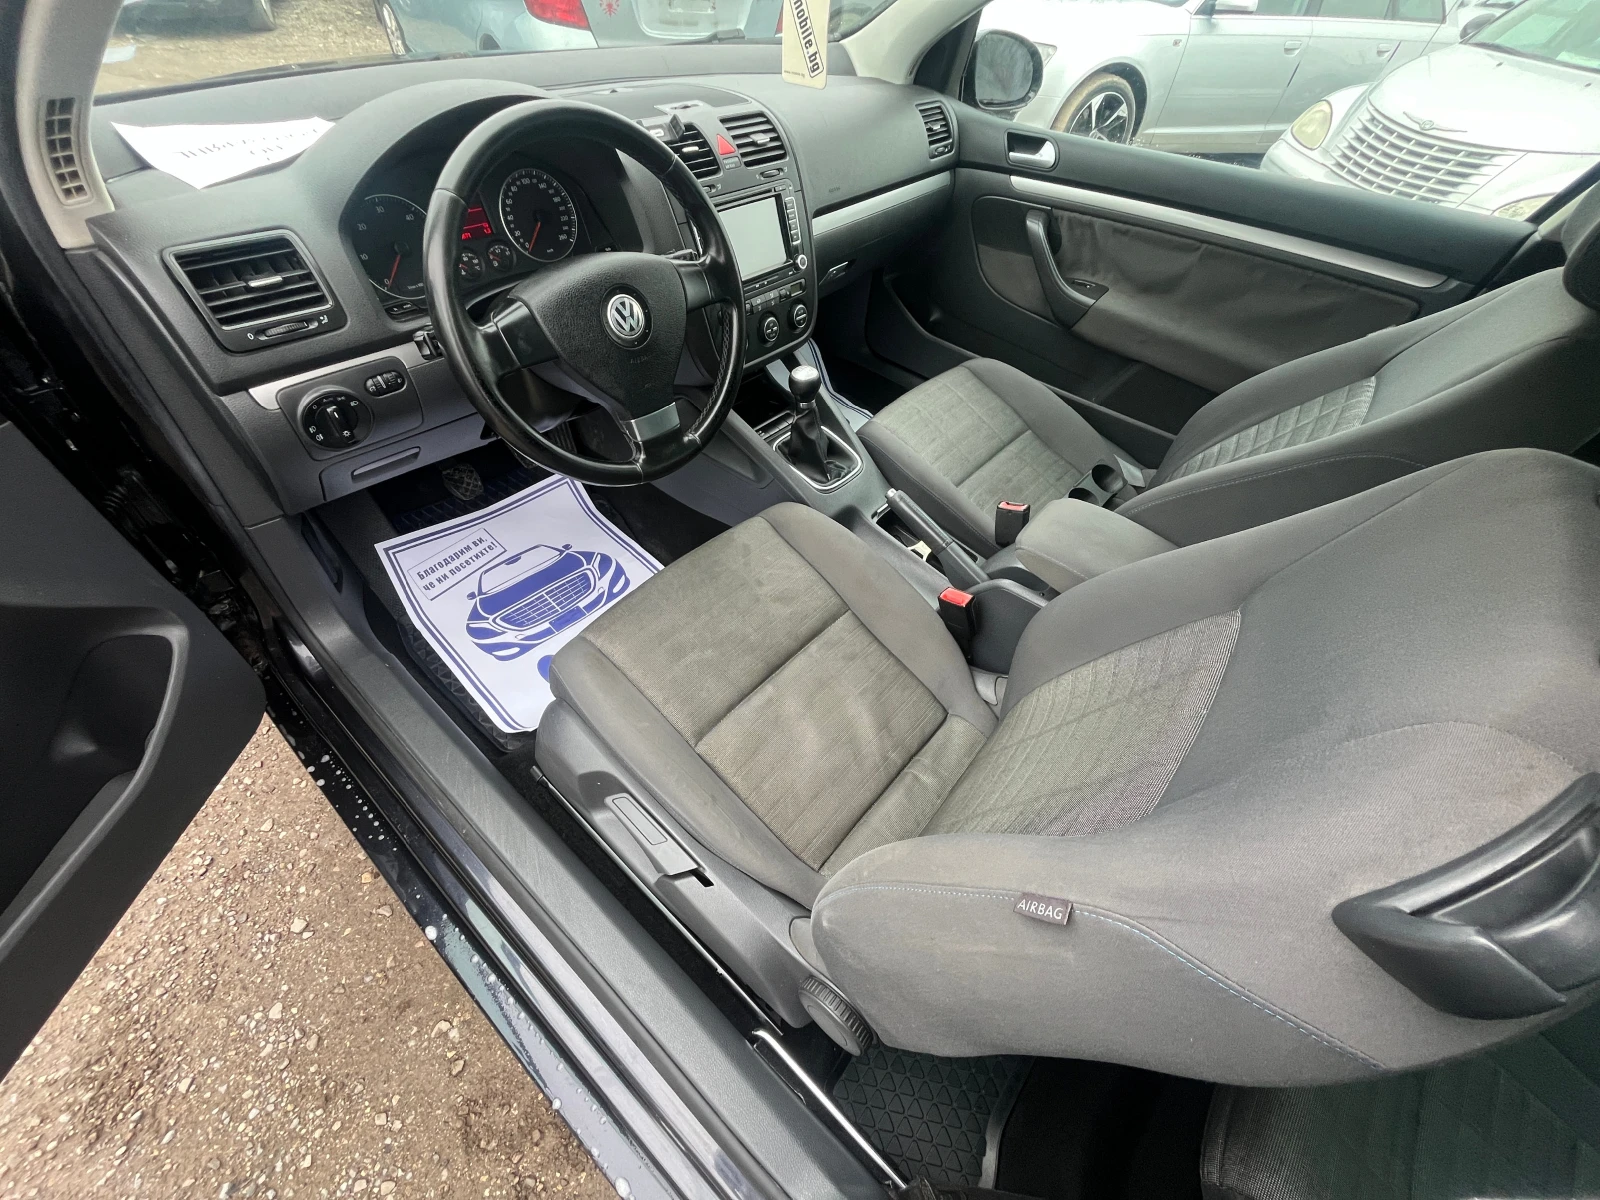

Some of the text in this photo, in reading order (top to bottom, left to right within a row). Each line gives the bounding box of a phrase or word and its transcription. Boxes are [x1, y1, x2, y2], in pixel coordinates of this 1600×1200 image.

[416, 544, 473, 580] Благодарим
[422, 541, 498, 591] че ни посетихте!
[1017, 898, 1064, 920] AIRBAG
